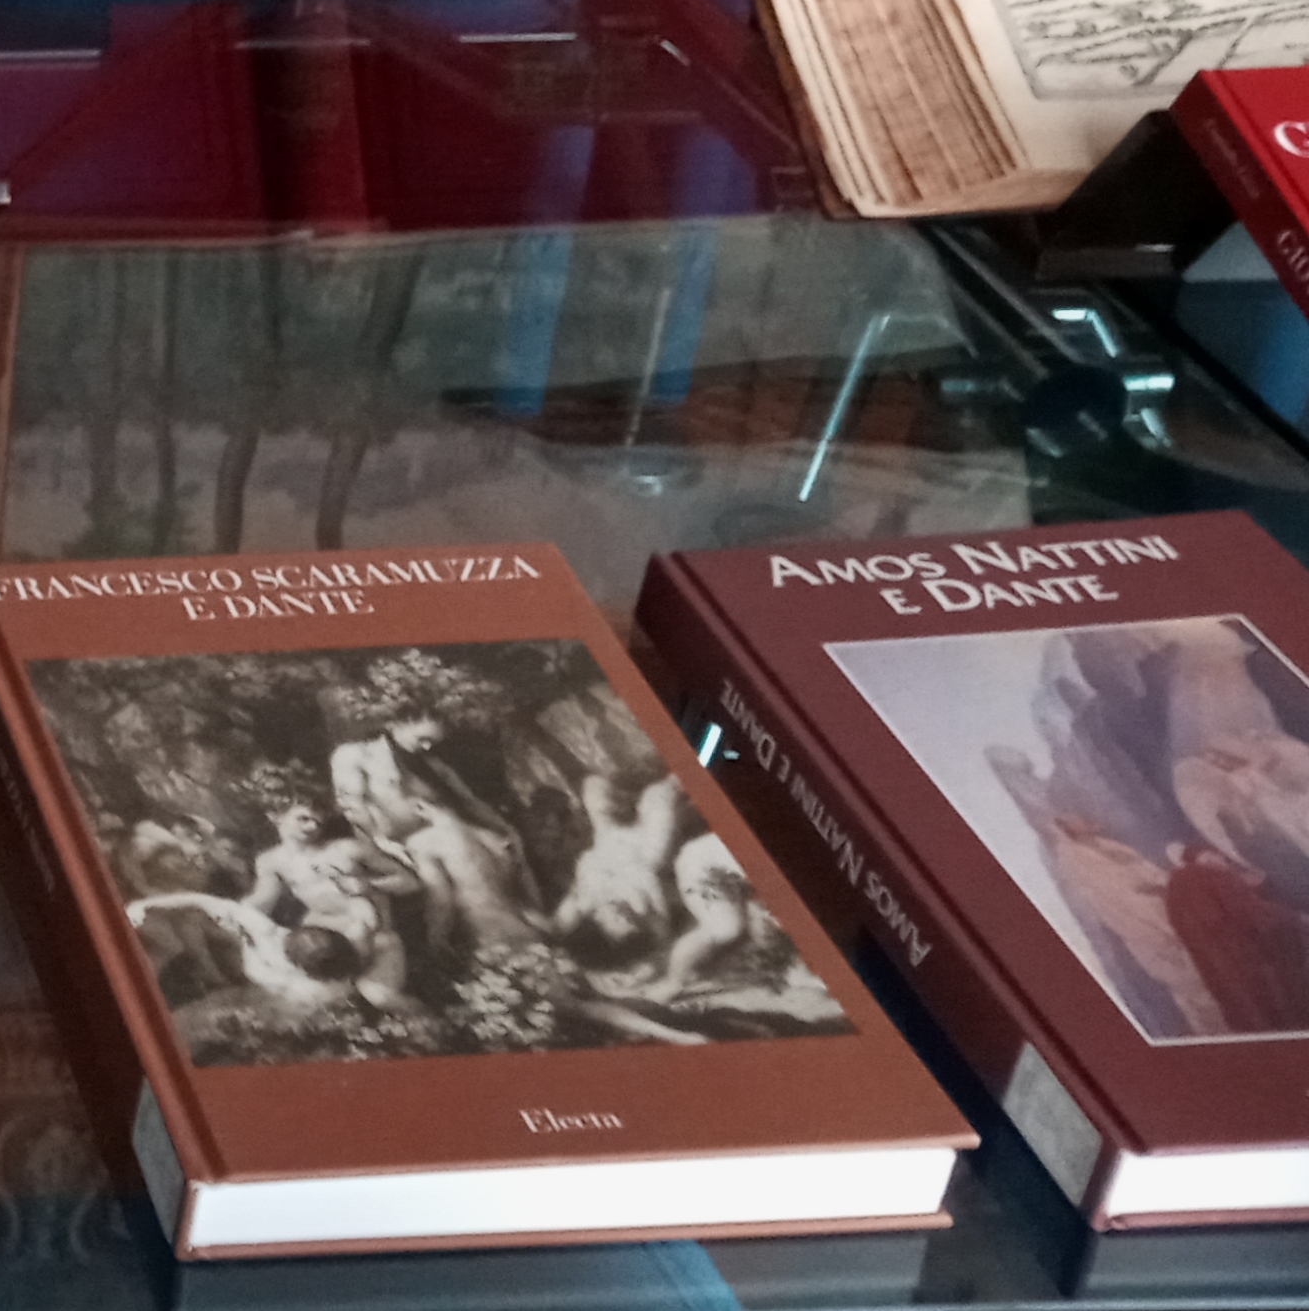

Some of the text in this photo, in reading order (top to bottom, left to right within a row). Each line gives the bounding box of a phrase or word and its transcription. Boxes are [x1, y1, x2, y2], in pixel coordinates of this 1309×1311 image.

[251, 554, 542, 591] SCARAMUZZA
[181, 590, 375, 621] E DANTE
